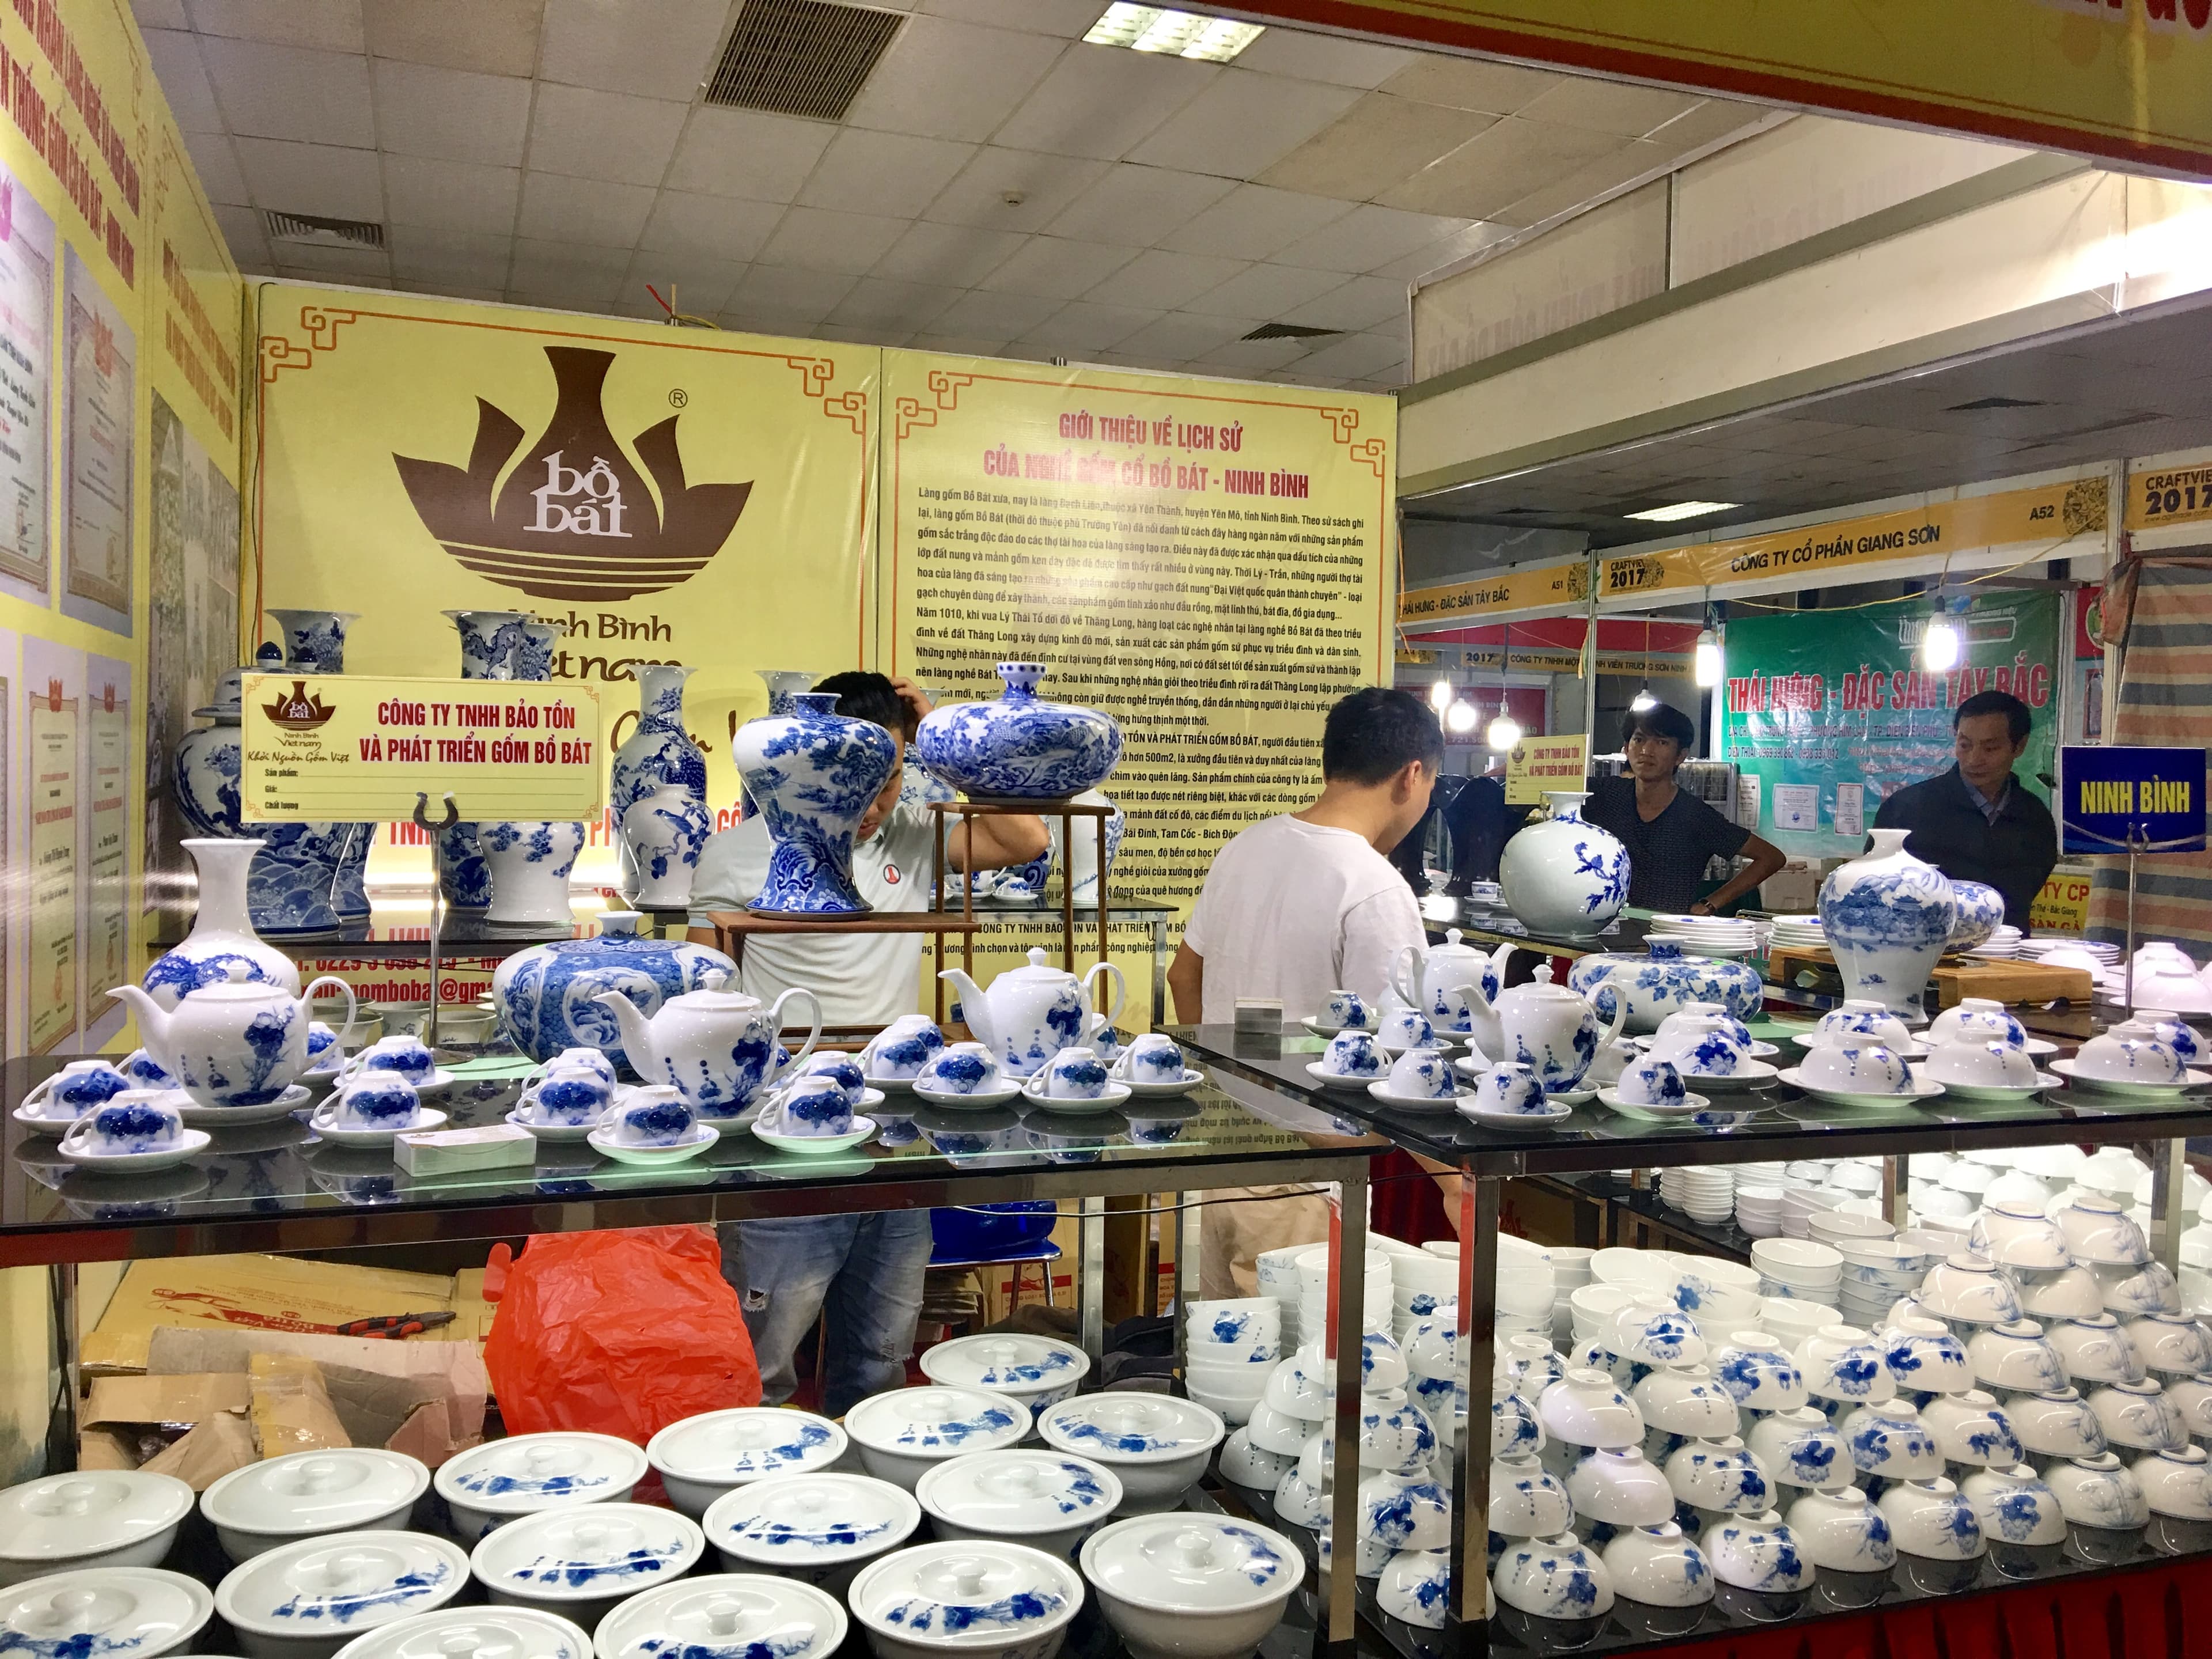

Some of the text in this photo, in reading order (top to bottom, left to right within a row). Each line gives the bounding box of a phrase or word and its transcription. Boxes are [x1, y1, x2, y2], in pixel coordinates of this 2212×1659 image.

[13, 58, 45, 159] THỐNG
[48, 107, 67, 190] GỐM
[1059, 411, 1243, 453] GIỚI THIỆU VỀ LỊCH SỬ
[541, 450, 619, 498] bồ
[984, 444, 1020, 476] CỦA
[1149, 457, 1172, 488] BỒ
[1177, 461, 1209, 491] BÁT
[1225, 469, 1265, 496] NINH
[1270, 468, 1309, 499] BÌNH
[523, 490, 632, 537] bát
[2029, 505, 2054, 520] A52
[2145, 484, 2212, 515] 2017
[1731, 524, 1940, 573] CÔNG TY CỔ PHẦN GIANG SƠN
[1552, 580, 1563, 590] A51
[1611, 569, 1646, 588] 2017
[1457, 590, 1474, 608] SẢN
[1475, 589, 1491, 605] TÂY
[1492, 586, 1510, 603] BẮC
[596, 613, 671, 642] Bình
[916, 607, 1362, 638] Năm 1010, khi vua Lý Thái Tổ dời đô về Thăng Long, hàng loạt các nghệ nhân tại làng nghề Bồ Bát đã theo triều
[1466, 652, 1494, 662] 2017
[1728, 669, 1766, 712] THÁI
[1842, 664, 1885, 719] ĐẶC
[378, 698, 575, 729] CÔNG TY TNHH BẢO TỒN
[359, 732, 592, 764] VÀ PHÁT TRIỂN GỐM BỒ BÁT
[1128, 730, 1315, 748] TỒN VÀ PHÁT TRIỂN GỐM BỒ BÁT, người đầu tiên
[248, 751, 269, 762] Khởi
[272, 751, 303, 765] Nguồn
[331, 752, 349, 764] Việt
[1110, 769, 1323, 786] chìm vào quên lãng. Sản phẩm chính của công ty là ấm
[2081, 774, 2190, 813] NINH BÌNH
[2067, 884, 2089, 902] CP
